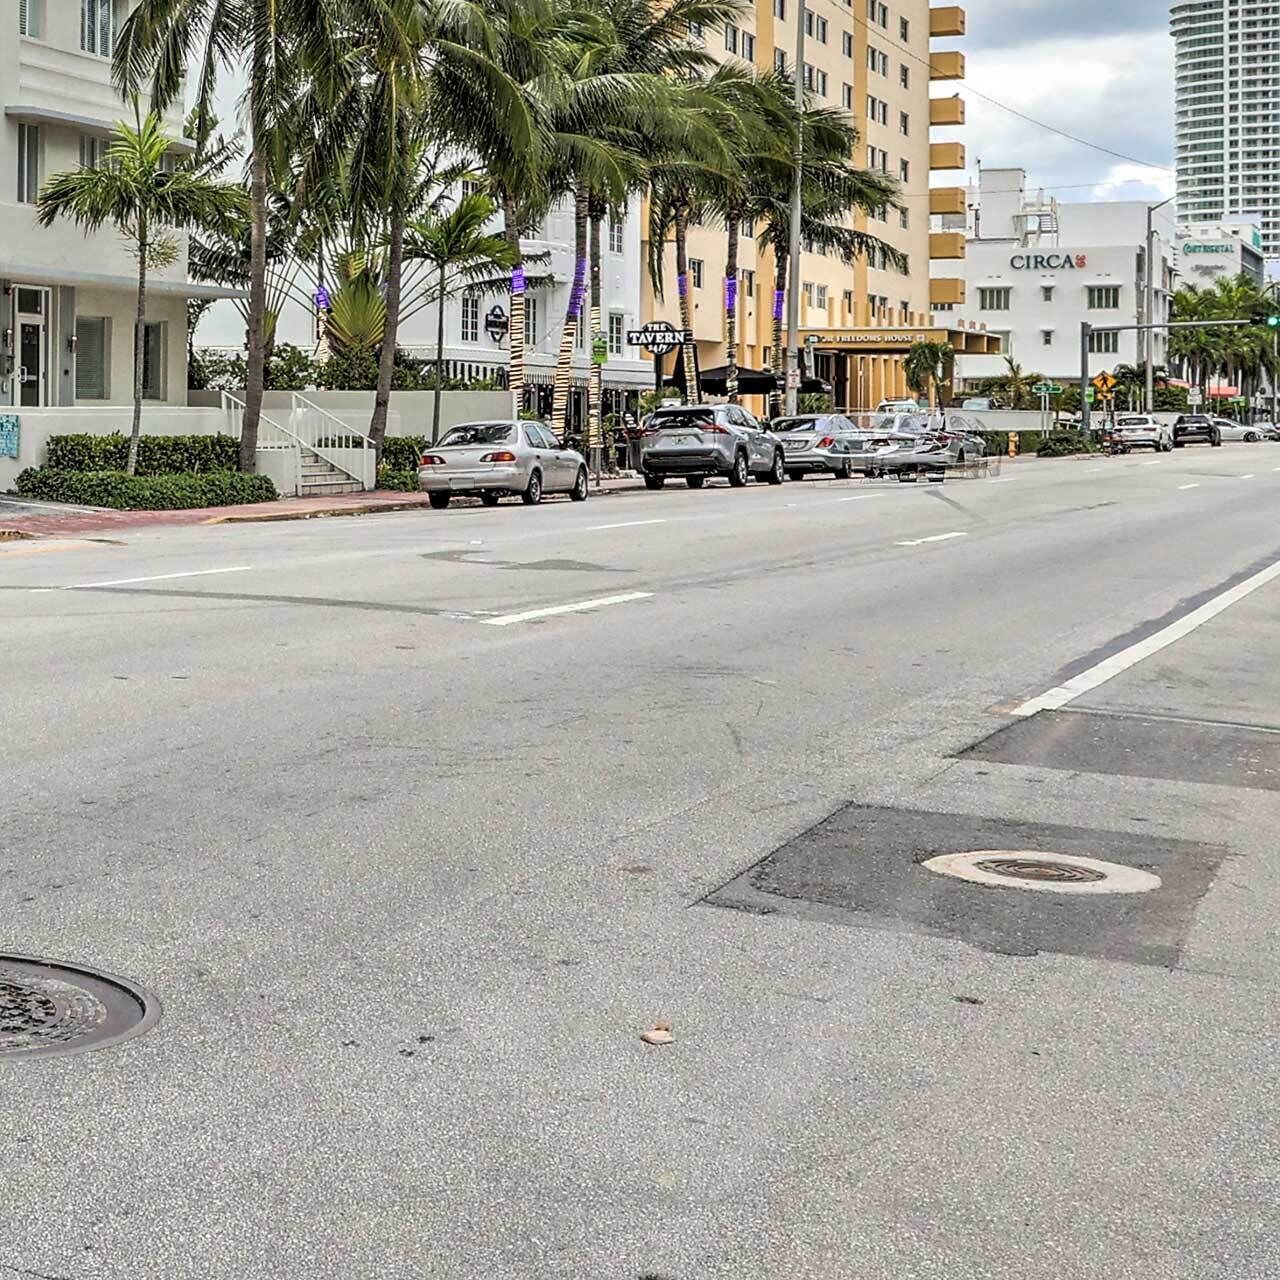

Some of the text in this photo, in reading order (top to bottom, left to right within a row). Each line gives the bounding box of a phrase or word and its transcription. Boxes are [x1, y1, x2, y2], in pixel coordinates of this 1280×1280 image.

[1010, 254, 1075, 270] CIRCA
[647, 323, 666, 331] THE
[629, 332, 685, 344] TAVERN
[836, 335, 882, 343] FREEDOMS
[884, 335, 913, 343] HOUSE
